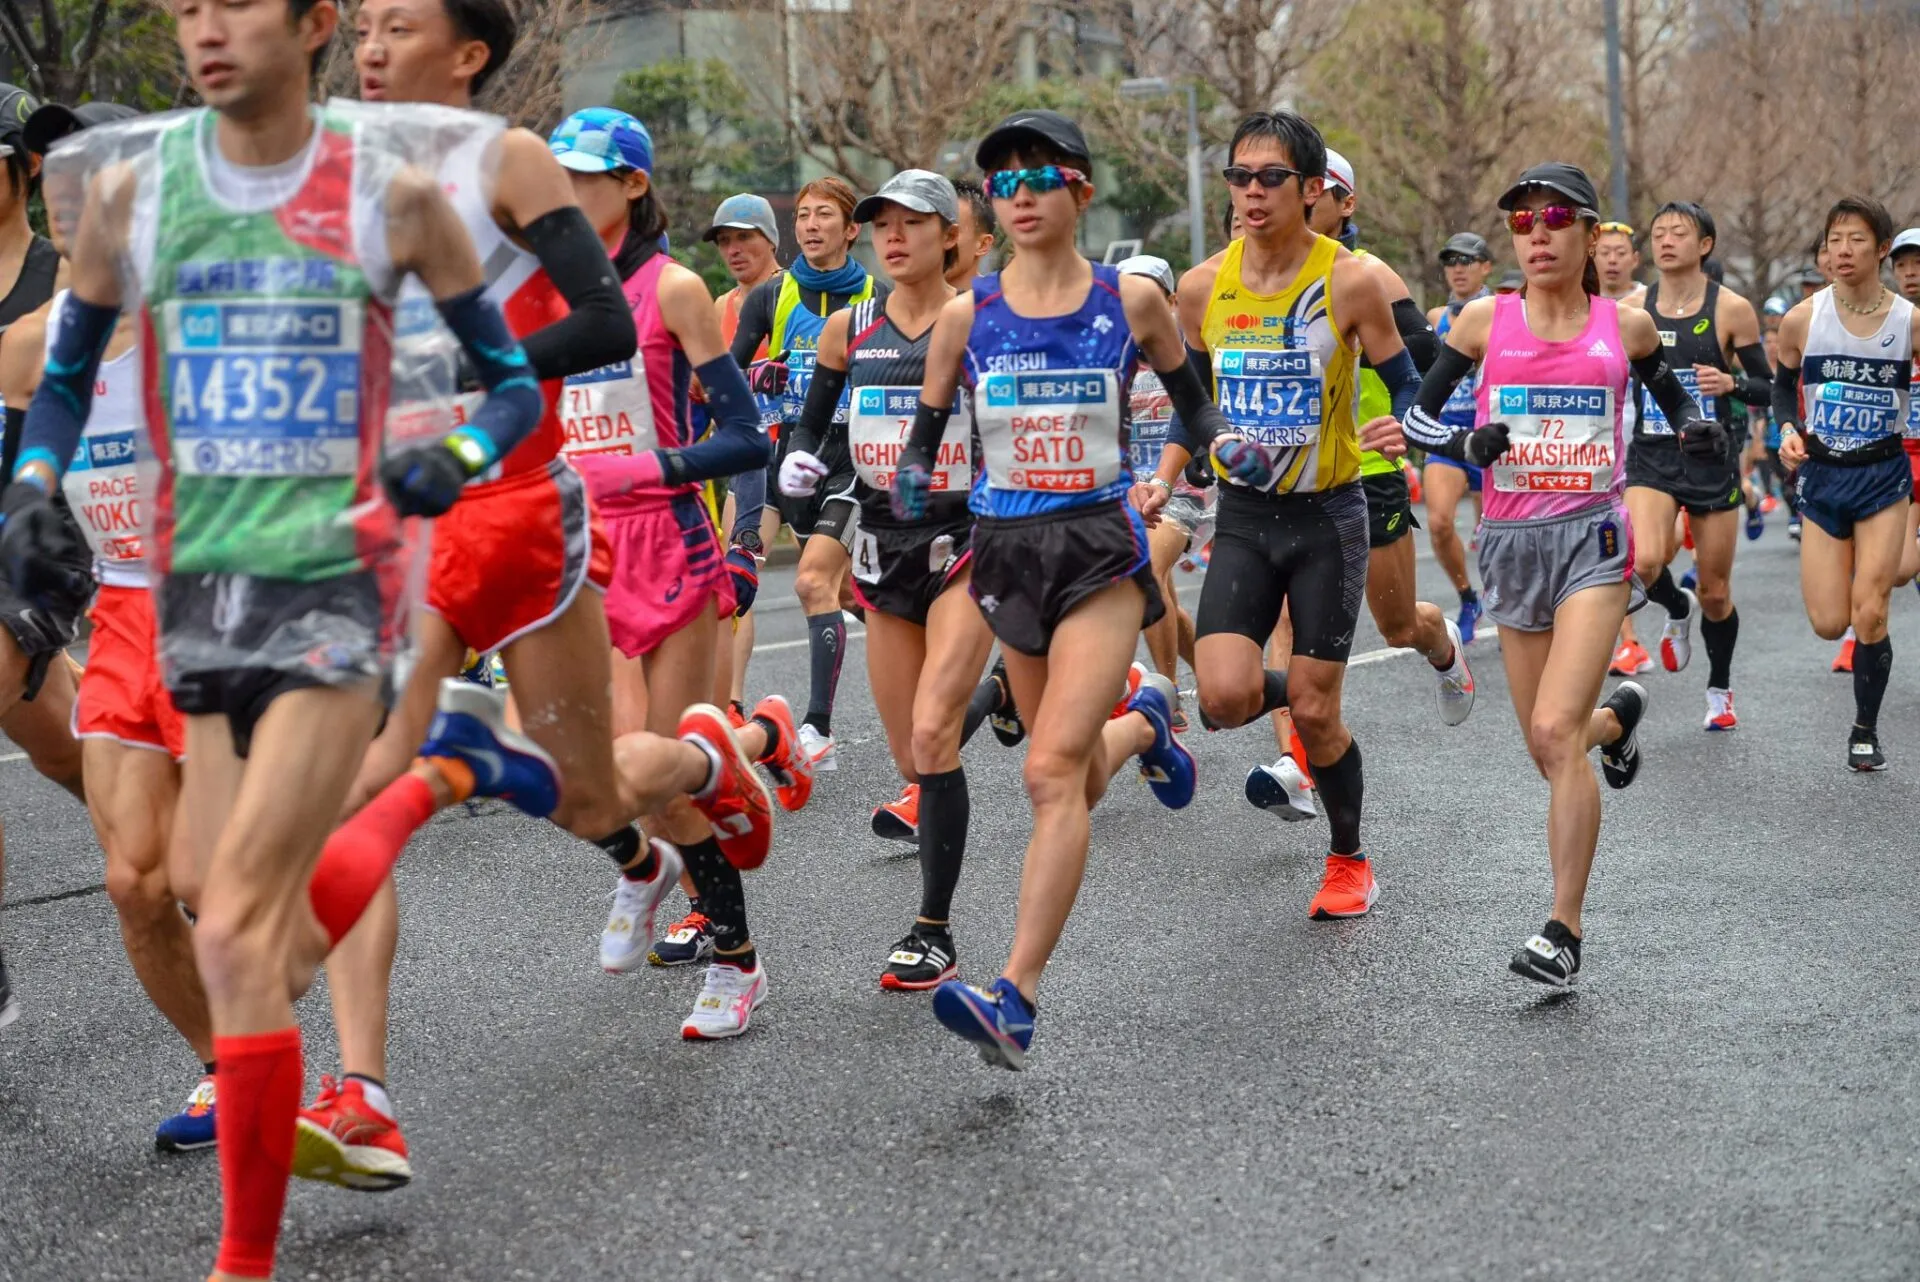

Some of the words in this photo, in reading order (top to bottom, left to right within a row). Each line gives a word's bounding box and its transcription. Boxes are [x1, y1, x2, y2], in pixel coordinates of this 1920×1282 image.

[227, 313, 336, 339] 東京メトロ
[855, 348, 900, 360] WACOAL
[986, 352, 1047, 372] SEKISUI
[1246, 358, 1306, 371] 東京メトロ
[1821, 359, 1897, 383] 新潟大学
[172, 357, 329, 423] A4352
[569, 389, 591, 412] 71
[1022, 381, 1101, 398] 東京メトロ
[1220, 379, 1304, 416] A4452
[1844, 389, 1890, 403] 東京メトロ
[1532, 395, 1601, 410] 東京メトロ
[565, 411, 635, 444] AEDA
[1011, 416, 1064, 433] PACE
[1814, 402, 1886, 432] A4205
[1540, 419, 1565, 439] 72
[854, 443, 967, 466] ICHIMA
[1013, 436, 1084, 463] SATO
[88, 477, 139, 499] PACE
[1028, 472, 1092, 487] ヤマザキ
[1531, 475, 1589, 488] ヤマザキ
[860, 538, 872, 574] 4
